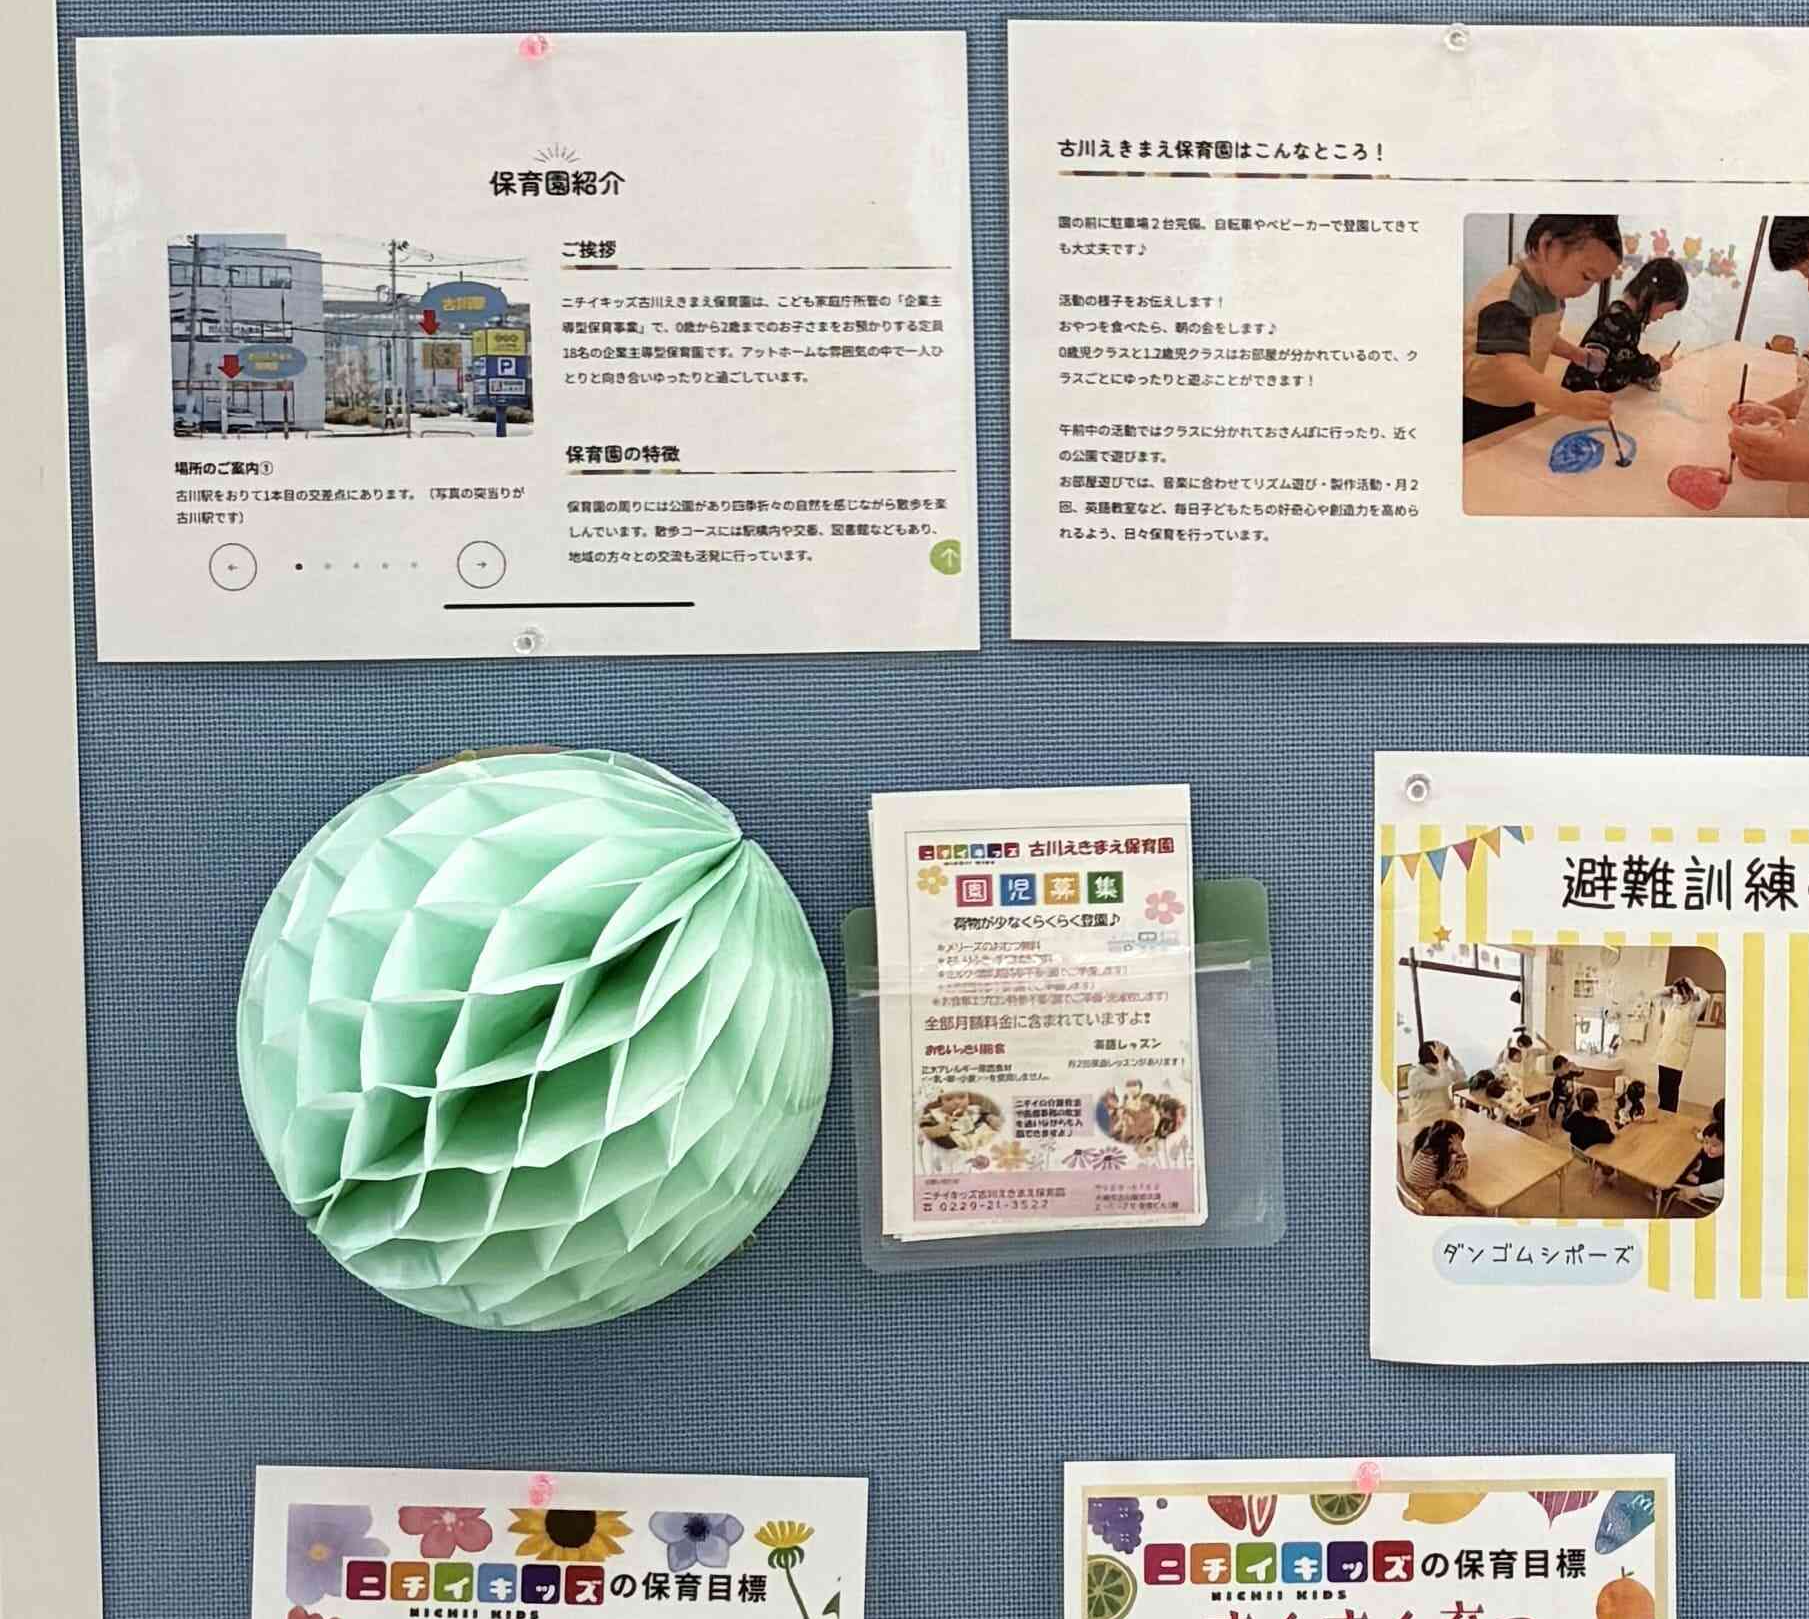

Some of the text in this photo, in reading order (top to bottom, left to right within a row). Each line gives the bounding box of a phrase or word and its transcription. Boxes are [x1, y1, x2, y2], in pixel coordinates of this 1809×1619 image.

[1057, 138, 1383, 162] 古川えきまえ保育園はこんなところ！
[488, 170, 626, 197] 保育園紹介
[561, 240, 617, 263] ご挨拶
[1058, 449, 1167, 464] の公園で遊びます。
[1028, 836, 1175, 858] 古川えきまえ保育園
[1443, 1242, 1635, 1266] ダンゴムシポーズ
[1211, 1589, 1347, 1602] NICHII KIDS
[410, 1608, 540, 1619] NICHII KIDS
